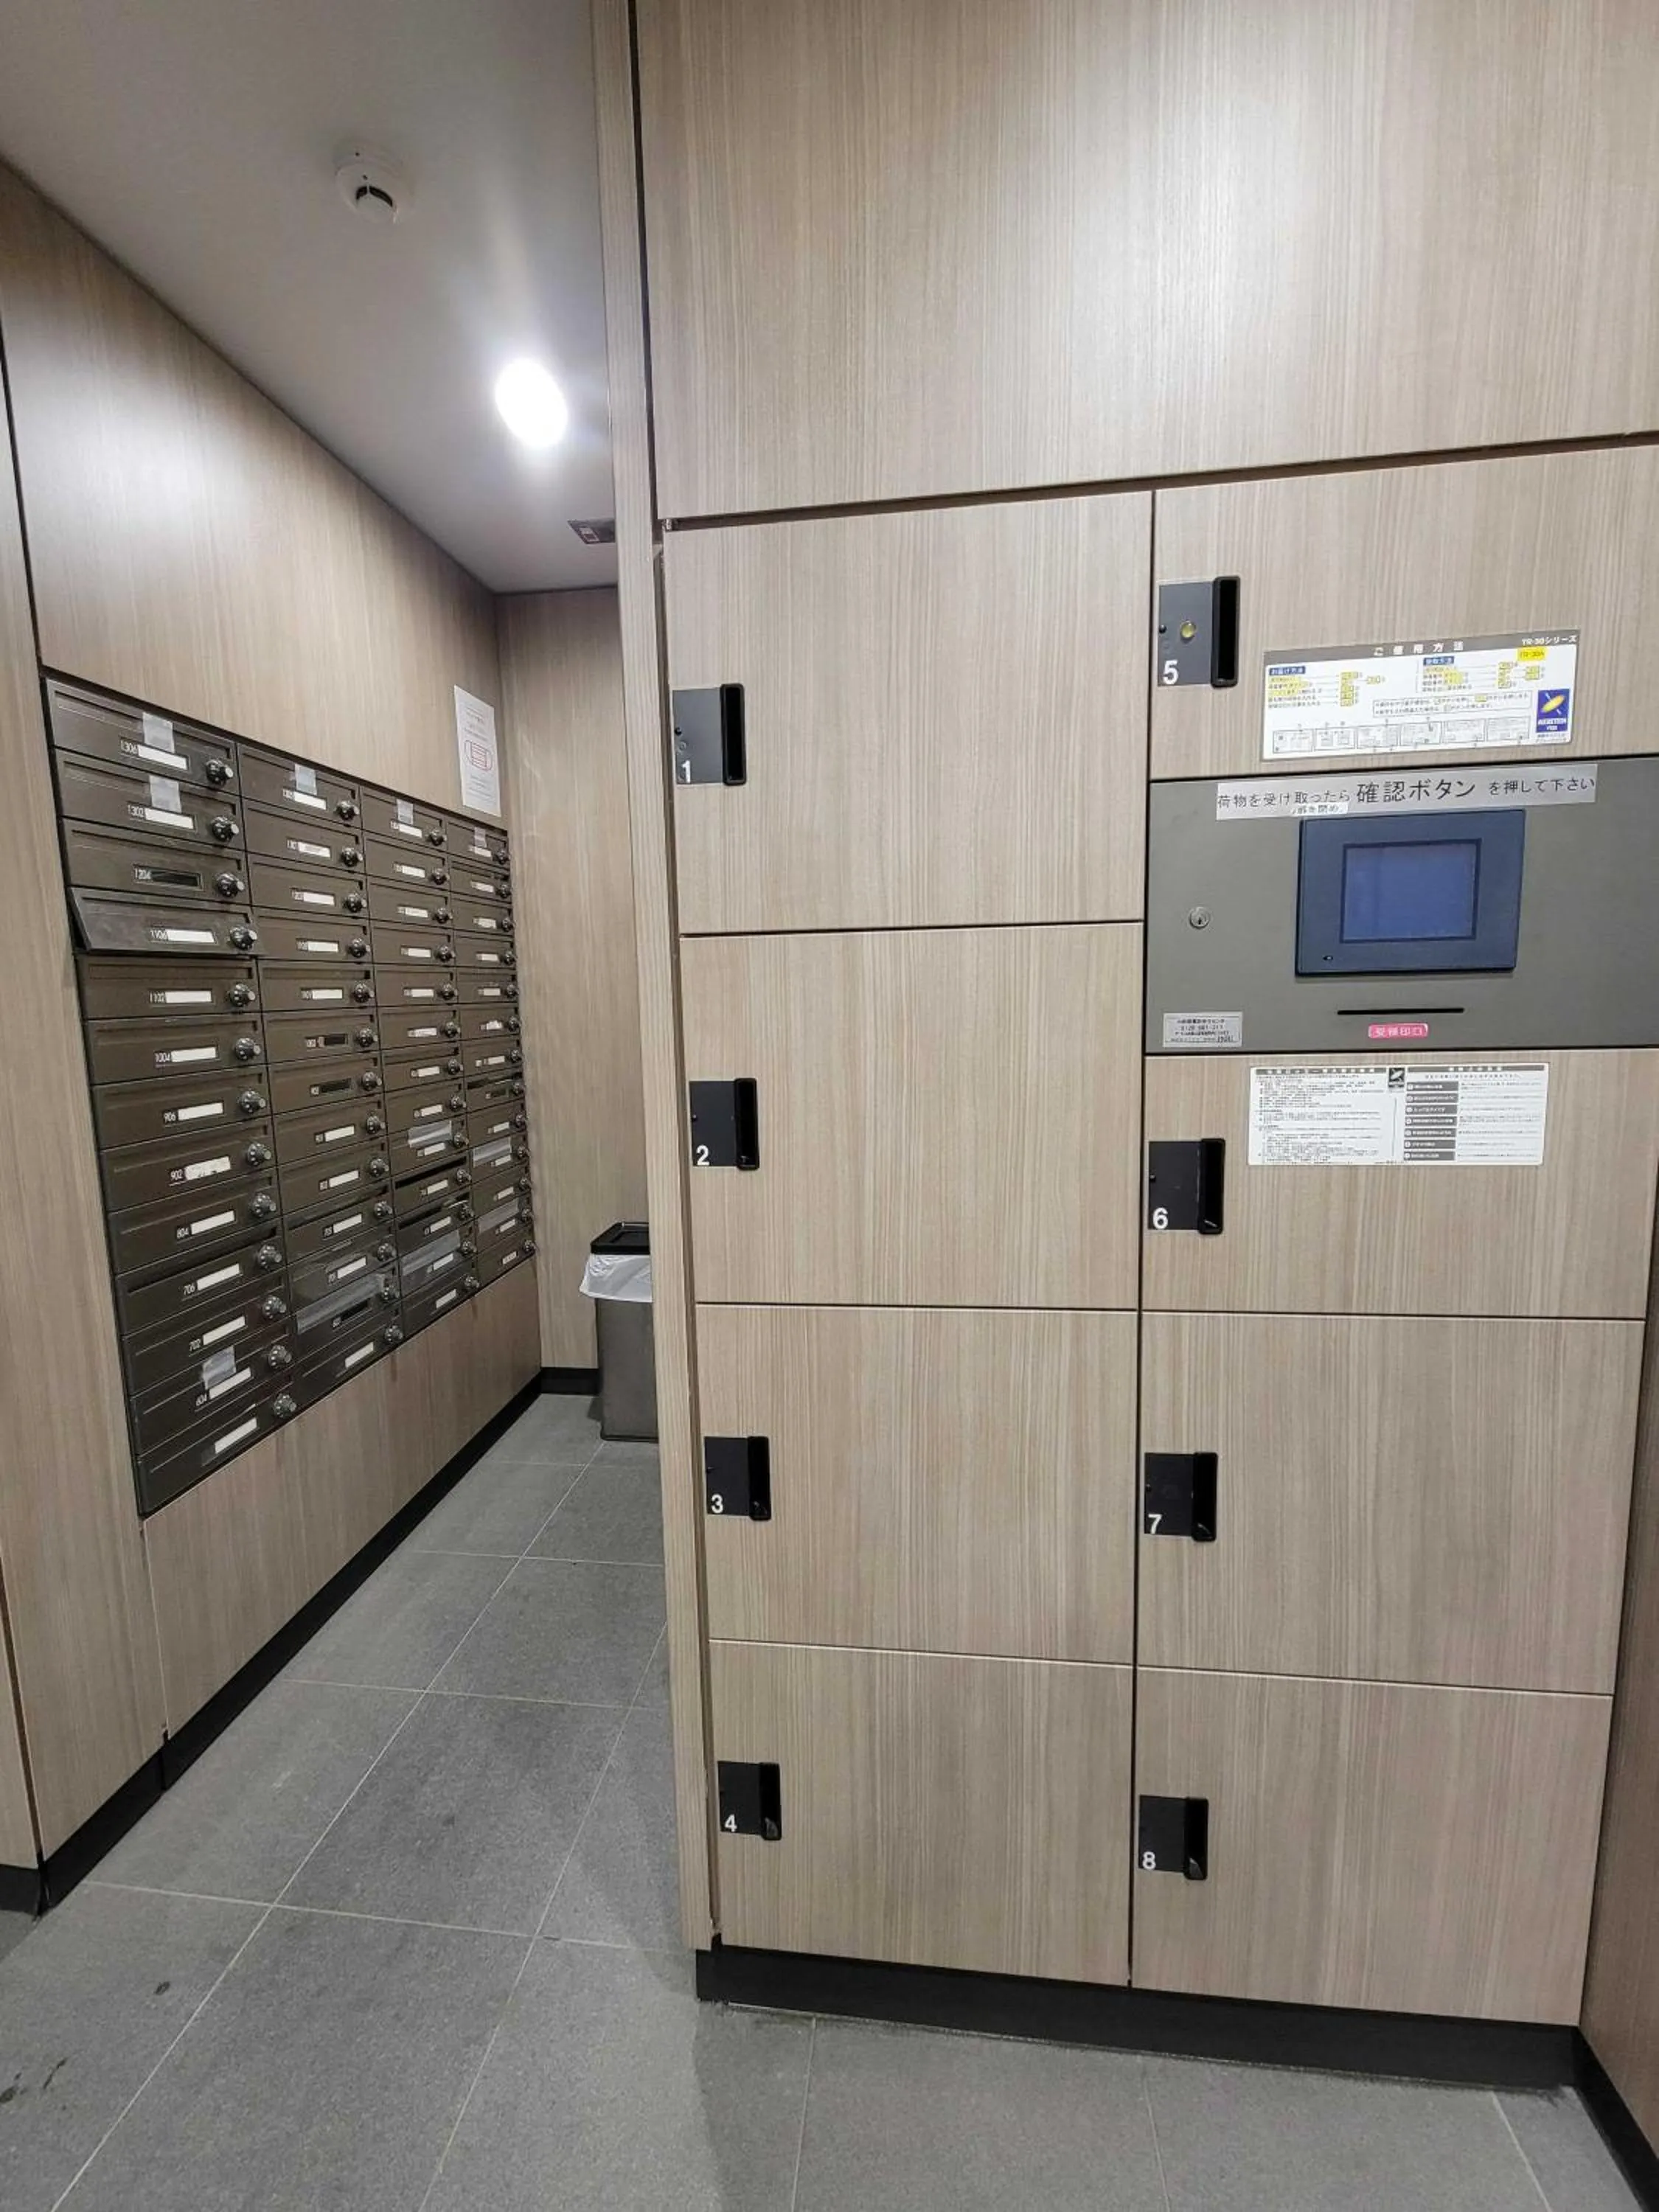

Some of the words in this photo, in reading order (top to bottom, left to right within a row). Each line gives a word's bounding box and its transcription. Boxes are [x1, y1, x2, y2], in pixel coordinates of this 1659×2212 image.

[1163, 659, 1178, 684] 5
[681, 759, 691, 783] 1
[1217, 790, 1350, 809] 荷物を受け取ったら
[1356, 779, 1475, 803] 確認ボタン
[1489, 777, 1595, 796] を押して下さい
[696, 1144, 709, 1166] 2
[1152, 1207, 1169, 1229] 6
[711, 1493, 723, 1514] 3
[1148, 1513, 1163, 1534] 7
[725, 1814, 737, 1833] 4
[1142, 1851, 1157, 1870] 8
